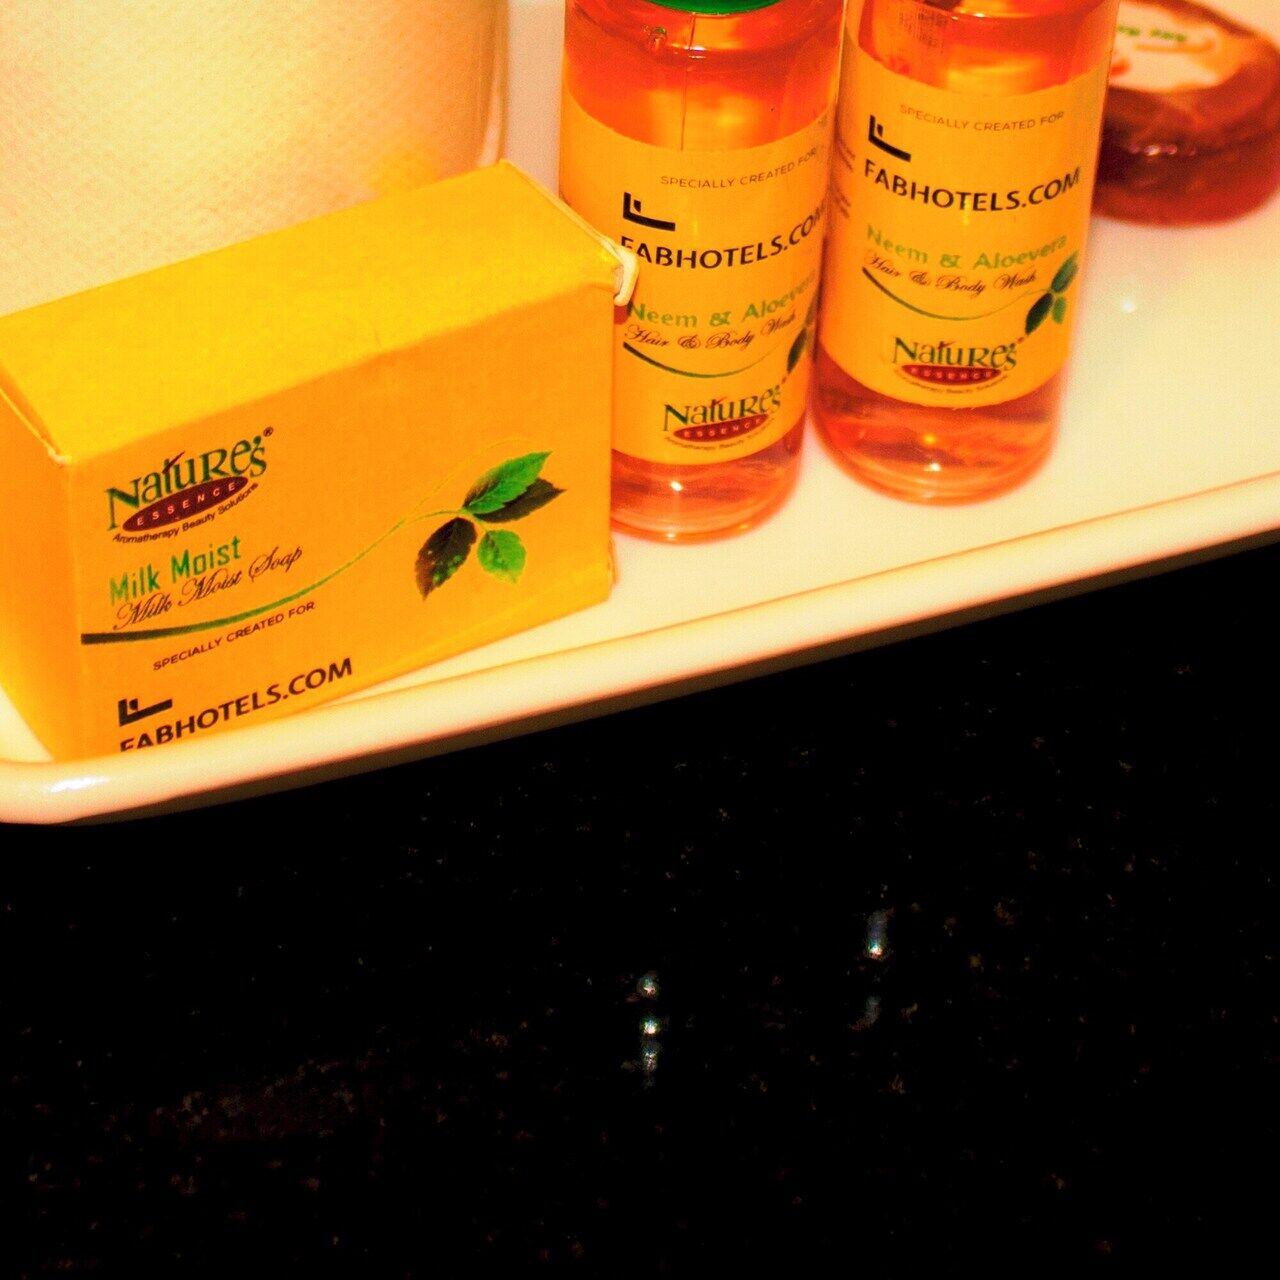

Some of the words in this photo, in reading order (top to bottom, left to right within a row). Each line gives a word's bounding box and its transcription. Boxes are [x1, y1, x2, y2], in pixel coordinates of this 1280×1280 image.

[899, 104, 969, 130] SPECIALLY
[973, 118, 1037, 132] CREATED
[1040, 111, 1065, 126] FOR
[660, 175, 735, 189] SPECIALLY
[739, 162, 795, 186] CREATED
[797, 147, 817, 167] FOR
[864, 158, 1081, 212] FABHOTELS.COM
[866, 224, 928, 265] Neem
[939, 254, 961, 269] &
[972, 235, 1068, 270] Aloevera
[862, 252, 902, 277] Hair
[909, 270, 931, 286] &
[935, 275, 987, 299] Body
[993, 267, 1037, 290] Wash
[624, 324, 669, 348] Hair
[677, 334, 702, 349] &
[705, 330, 756, 352] Body
[628, 303, 698, 328] Neem
[708, 310, 732, 326] &
[136, 481, 236, 526] ESSENCE
[113, 526, 180, 544] Aromatherapy
[182, 511, 216, 532] Beauty
[109, 564, 161, 606] Milk
[171, 535, 242, 584] Moist
[113, 592, 172, 631] Milk
[178, 567, 243, 607] Moist
[248, 546, 303, 582] Soap
[153, 638, 222, 671] SPECIALLY
[226, 613, 284, 642] CREATED
[288, 600, 316, 619] FOR
[119, 658, 353, 752] FABHOTELS.COM
